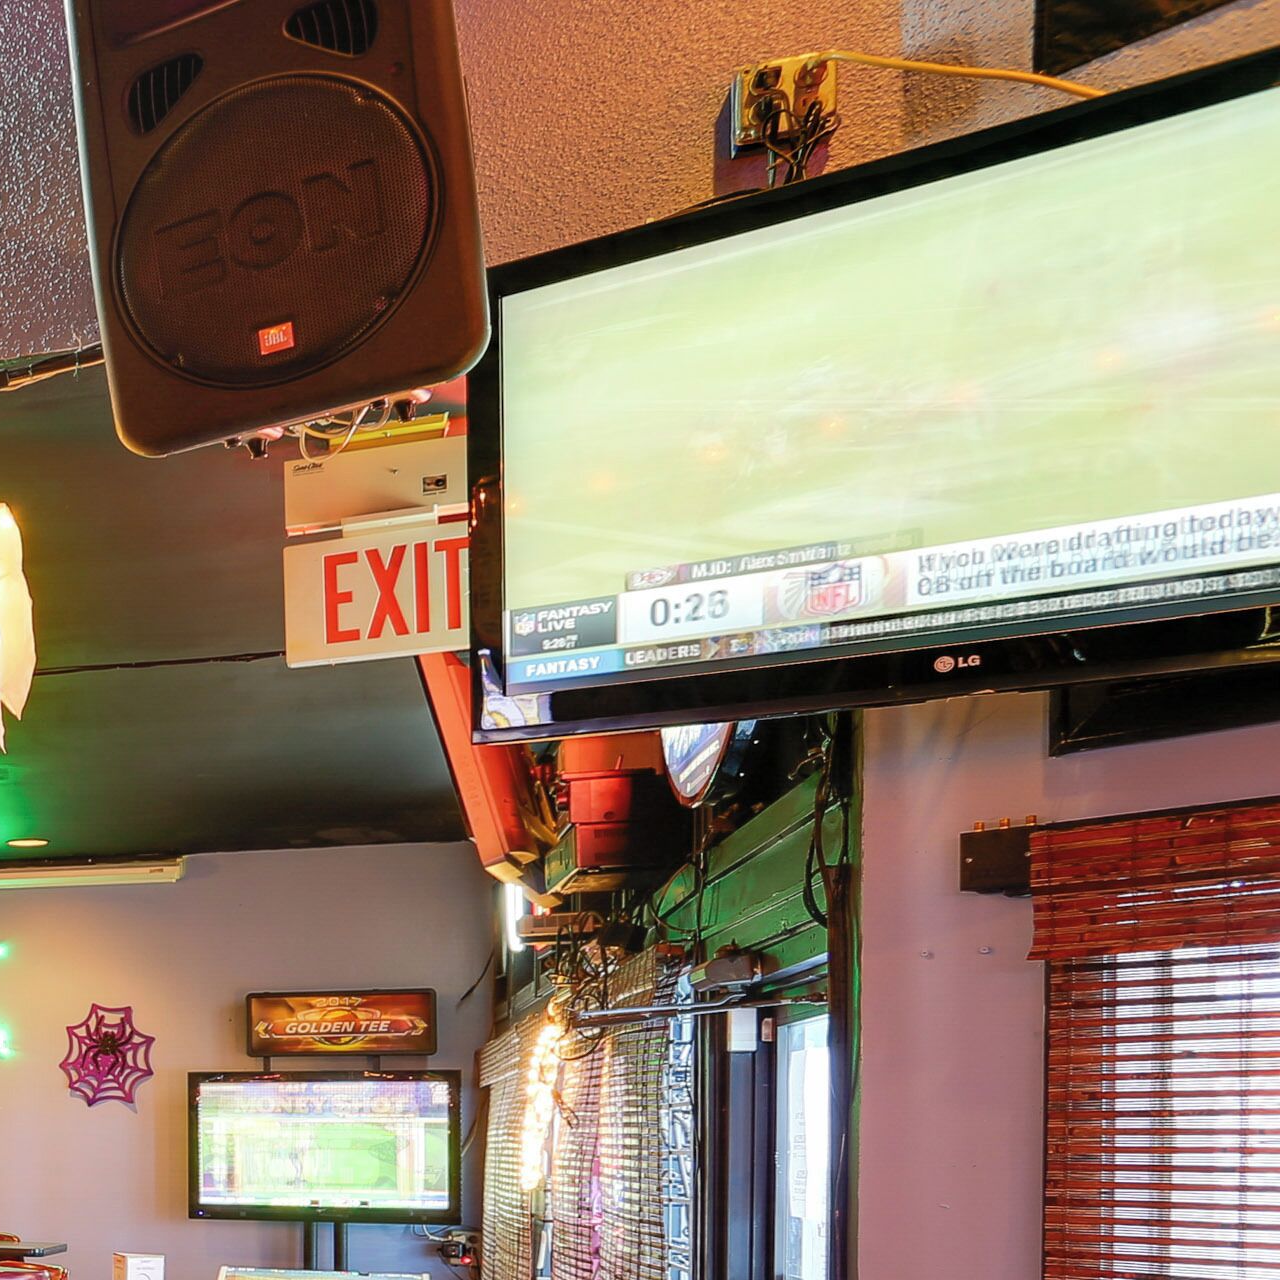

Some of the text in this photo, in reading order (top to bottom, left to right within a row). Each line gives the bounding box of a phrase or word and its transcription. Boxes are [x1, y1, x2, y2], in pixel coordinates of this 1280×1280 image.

[154, 157, 386, 304] EON
[322, 536, 470, 645] EXIT
[537, 601, 613, 622] FANTASY
[537, 618, 576, 633] LIVE
[526, 643, 702, 677] FANTASY LEADERS
[957, 654, 982, 669] LG
[316, 996, 363, 1008] 2017
[285, 1020, 391, 1034] GOLDEN TEE
